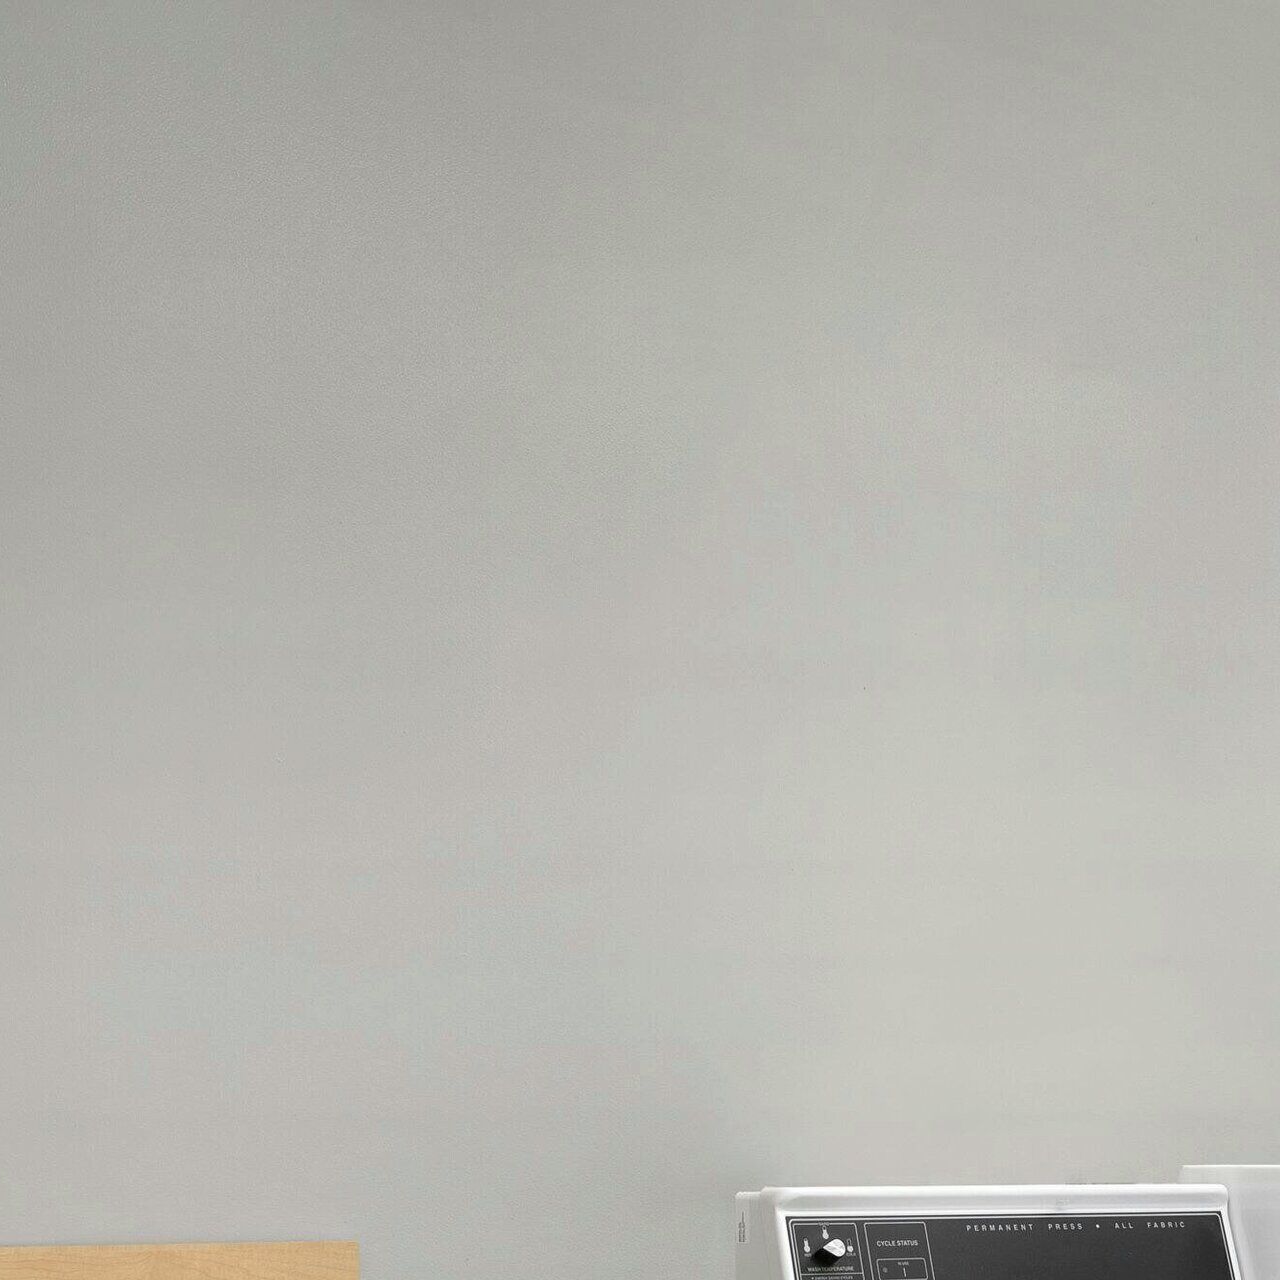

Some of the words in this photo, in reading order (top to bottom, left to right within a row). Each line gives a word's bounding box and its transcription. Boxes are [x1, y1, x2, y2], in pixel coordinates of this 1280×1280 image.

[966, 1223, 1033, 1232] PERMANENT
[1048, 1223, 1083, 1231] PRESS
[1147, 1221, 1185, 1229] FABRIC
[897, 1239, 919, 1247] STATUS
